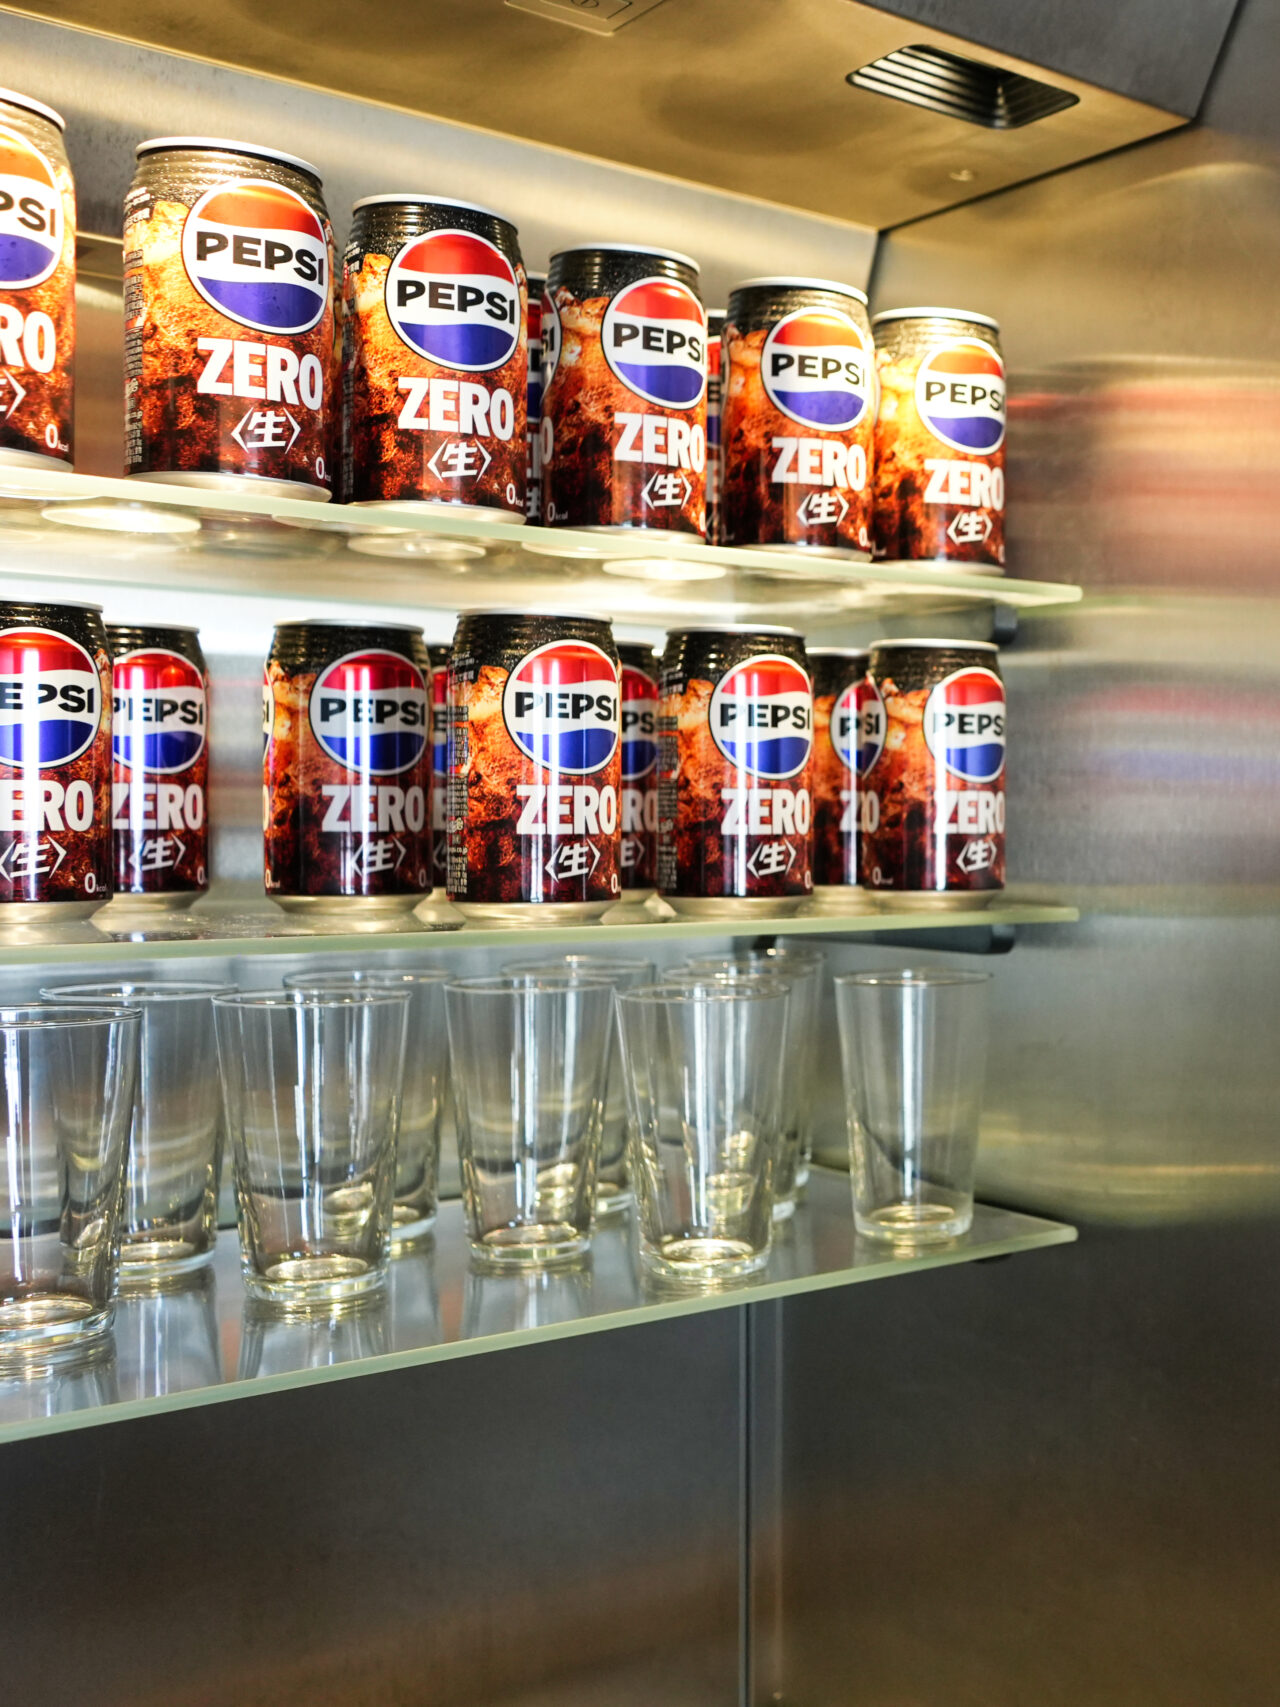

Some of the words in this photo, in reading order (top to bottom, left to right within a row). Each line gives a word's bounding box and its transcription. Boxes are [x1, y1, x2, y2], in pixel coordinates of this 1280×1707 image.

[0, 190, 56, 238] SI
[196, 231, 324, 286] PEPSI
[397, 279, 515, 325] PEPSI
[0, 304, 56, 374] RO
[613, 322, 705, 365] PEPSI
[197, 337, 323, 411] ZERO
[771, 353, 865, 387] PEPSI
[398, 377, 514, 441] ZERO
[614, 412, 704, 473] ZERO
[771, 437, 866, 491] ZERO
[924, 459, 1004, 511] ZERO
[0, 682, 94, 713] EPSI
[320, 697, 425, 727] PEPSI
[515, 692, 617, 722] PEPSI
[720, 703, 810, 730] PEPSI
[933, 713, 1004, 737] PEPS
[0, 779, 94, 832] ERO
[112, 782, 204, 830] ZERO
[321, 784, 425, 833] ZERO
[516, 784, 617, 835] ZERO
[622, 788, 656, 833] RO
[721, 788, 810, 835] ZERO
[933, 790, 1005, 835] ZERO
